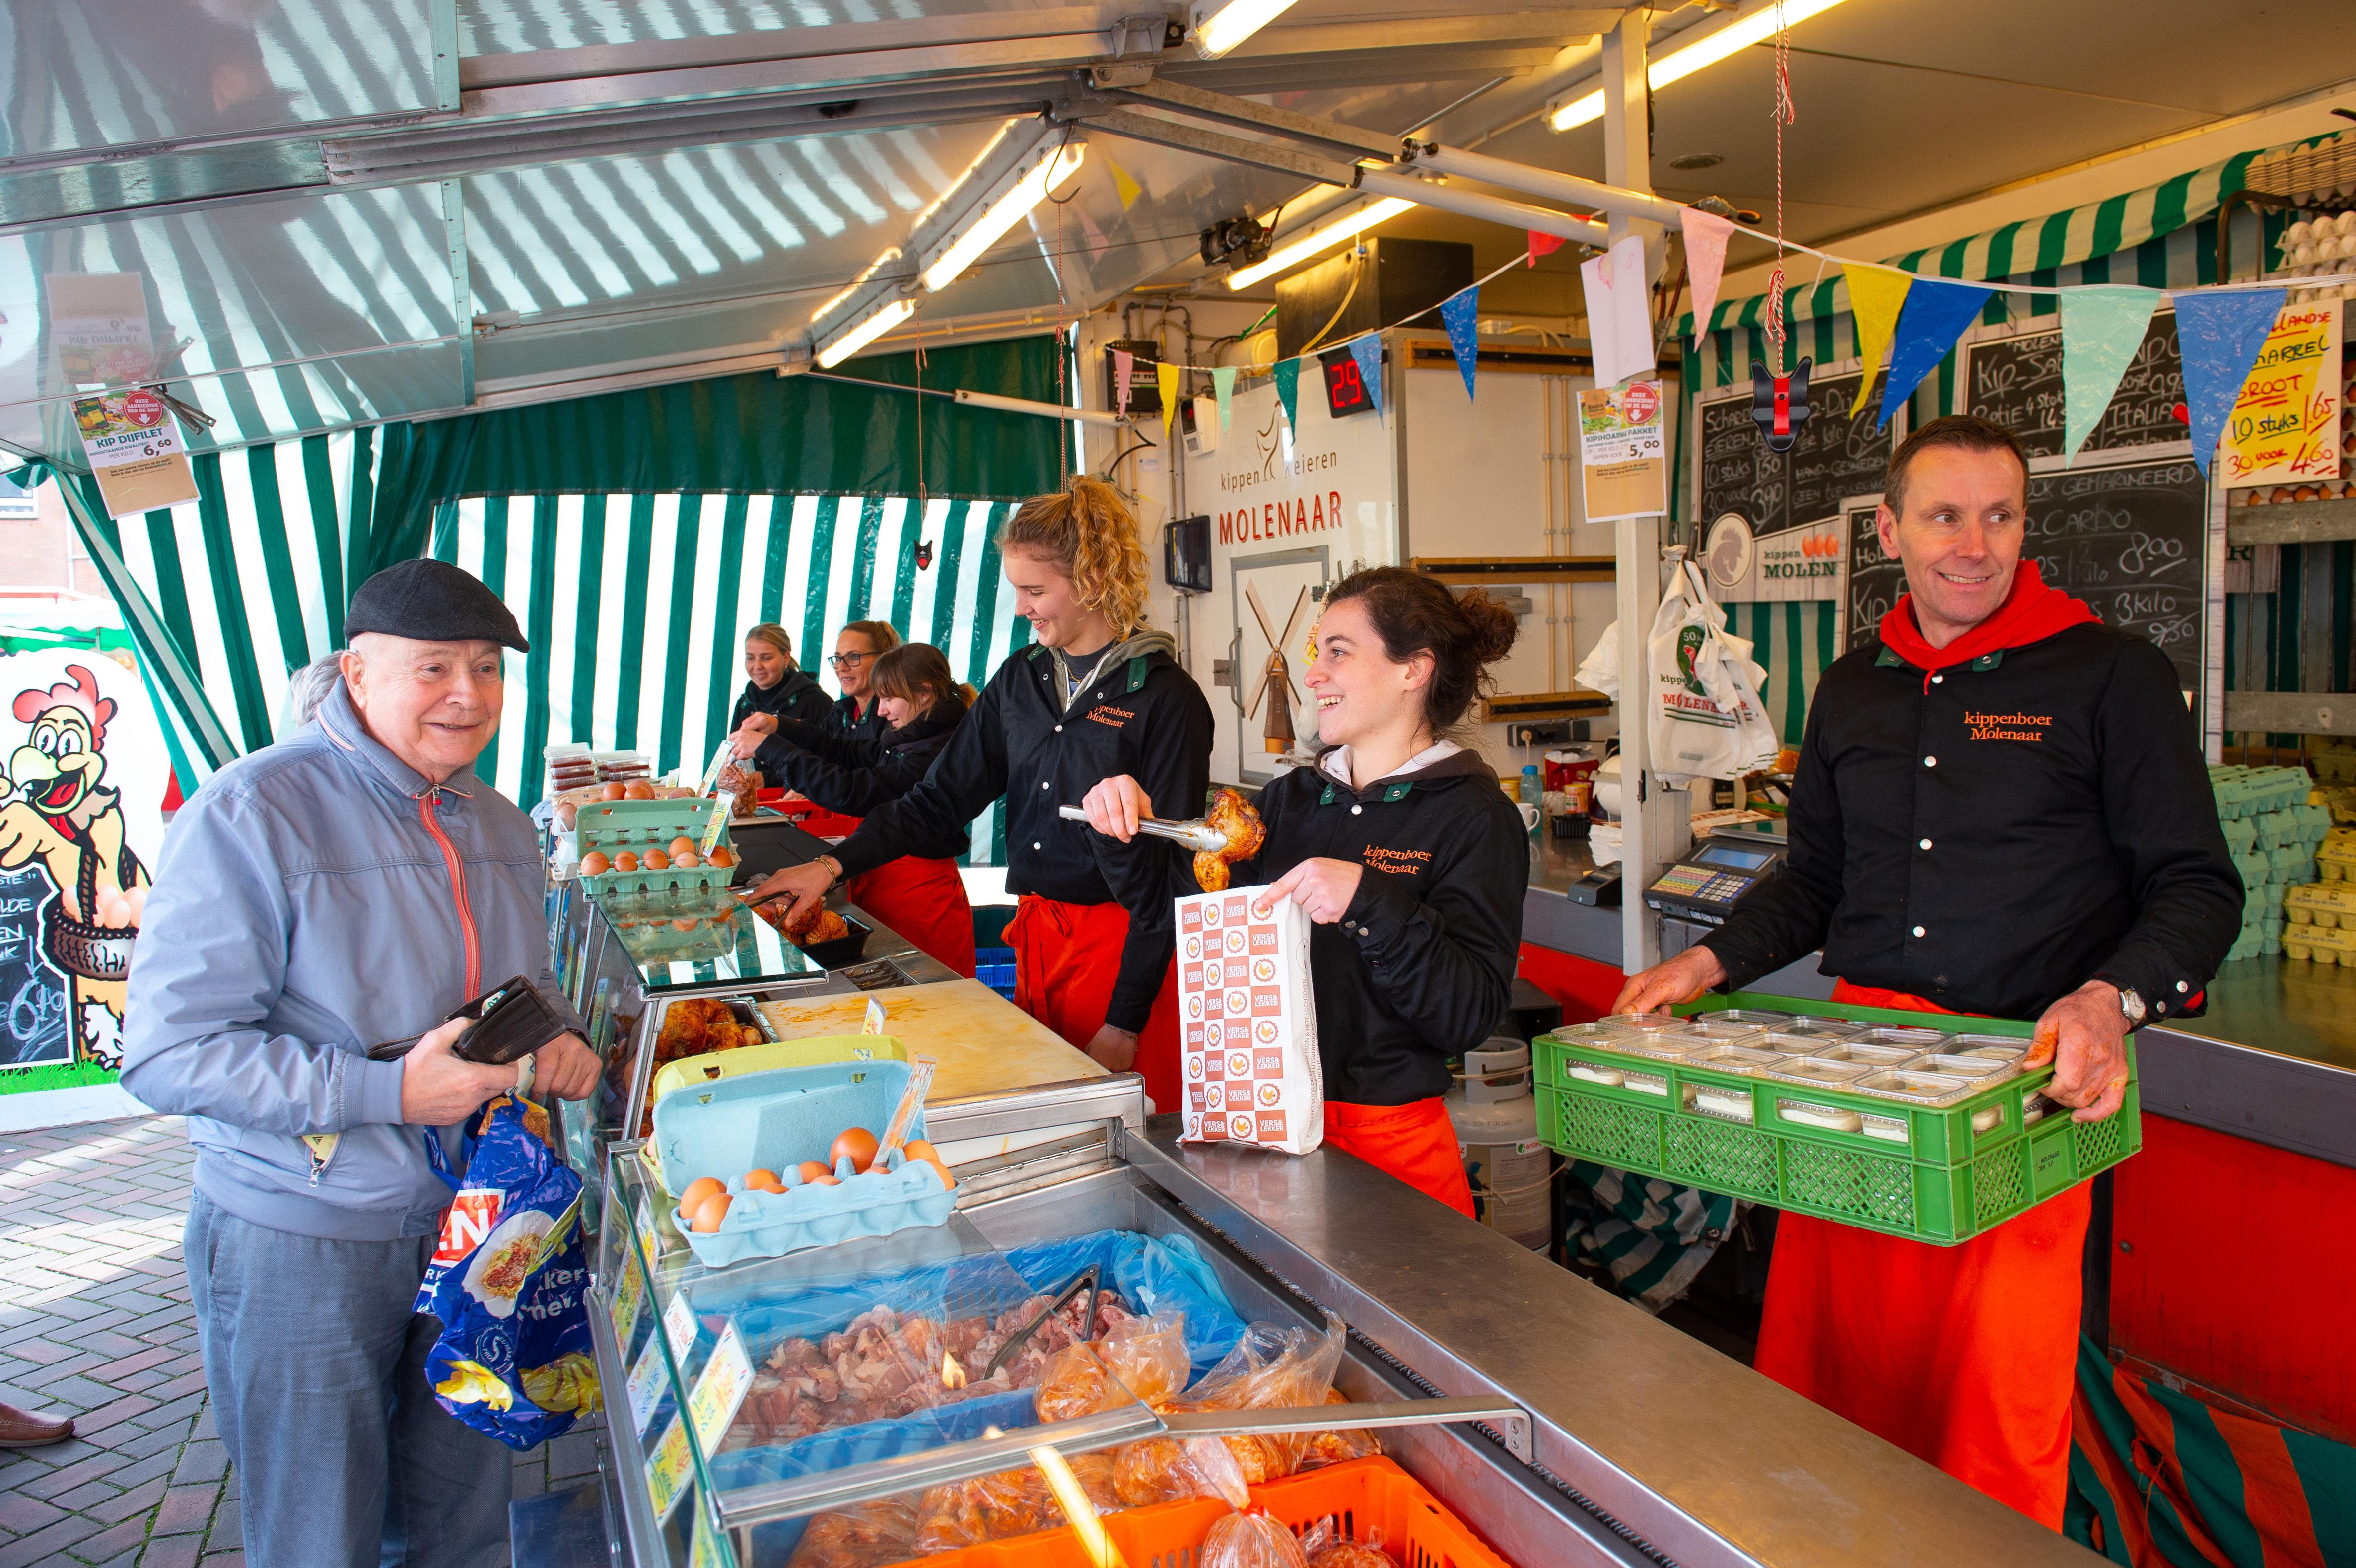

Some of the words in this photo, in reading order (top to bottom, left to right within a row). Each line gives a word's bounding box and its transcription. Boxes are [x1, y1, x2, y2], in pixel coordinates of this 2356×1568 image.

[1332, 359, 1363, 409] 29
[96, 438, 116, 448] KIP
[118, 428, 163, 444] DIJFILET
[1221, 471, 1260, 494] kippen
[1294, 451, 1337, 475] eieren
[1220, 491, 1342, 545] MOLENAAR
[1764, 547, 1801, 560] kippen
[1764, 562, 1836, 578] MOLEN
[1683, 632, 1697, 642] 50
[1086, 710, 1124, 728] Molenaar
[1963, 711, 2053, 728] kippenboer
[1970, 727, 2042, 741] Molenaar
[1363, 844, 1431, 862] kippenboer
[1365, 859, 1420, 875] Molenaar
